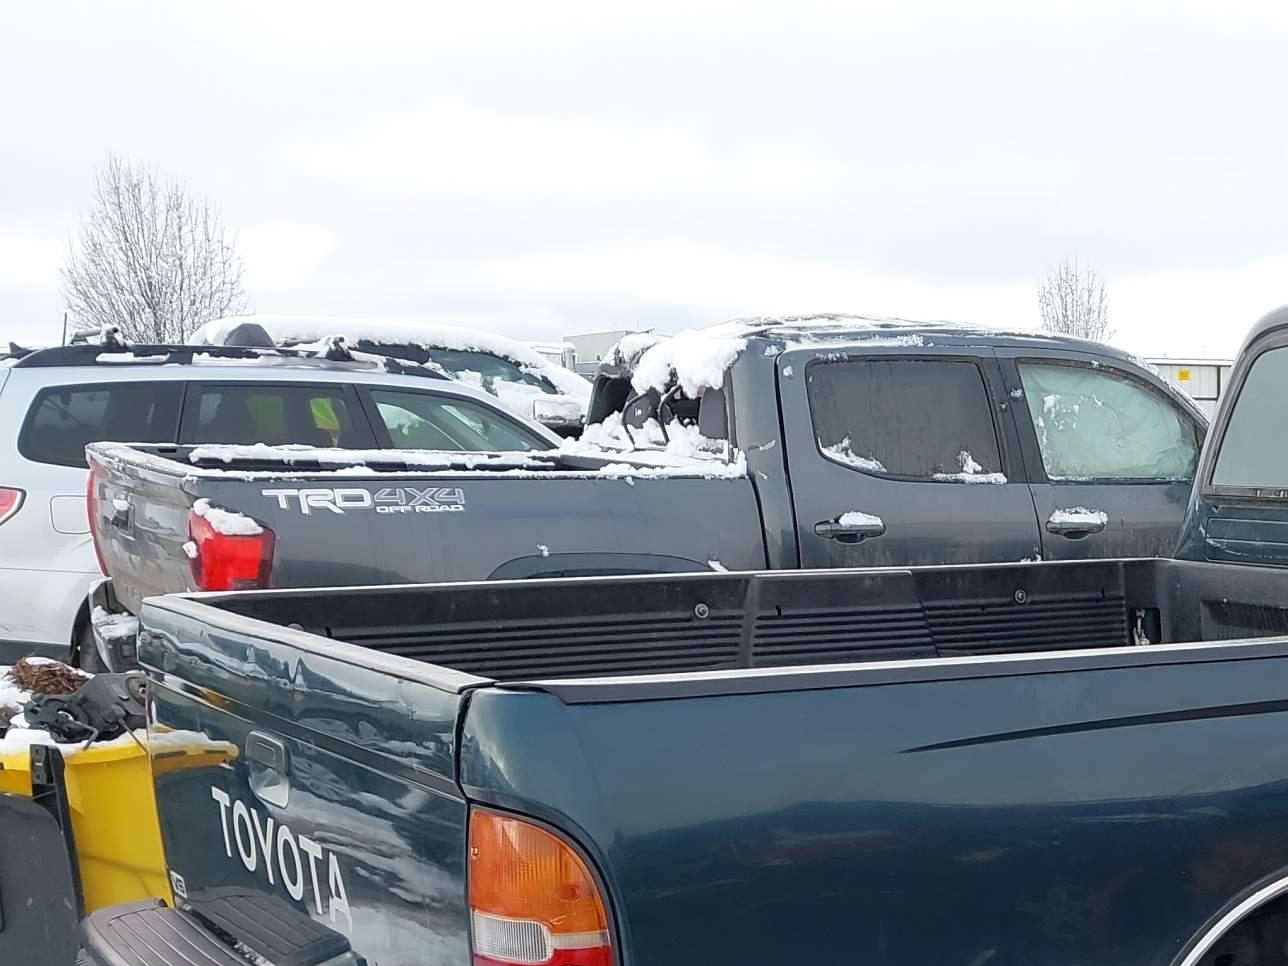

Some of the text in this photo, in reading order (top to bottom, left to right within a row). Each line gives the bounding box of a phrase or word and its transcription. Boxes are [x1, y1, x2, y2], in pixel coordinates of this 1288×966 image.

[261, 487, 374, 515] TRD
[375, 504, 466, 514] OFF ROAD
[211, 786, 353, 932] TOYOTA
